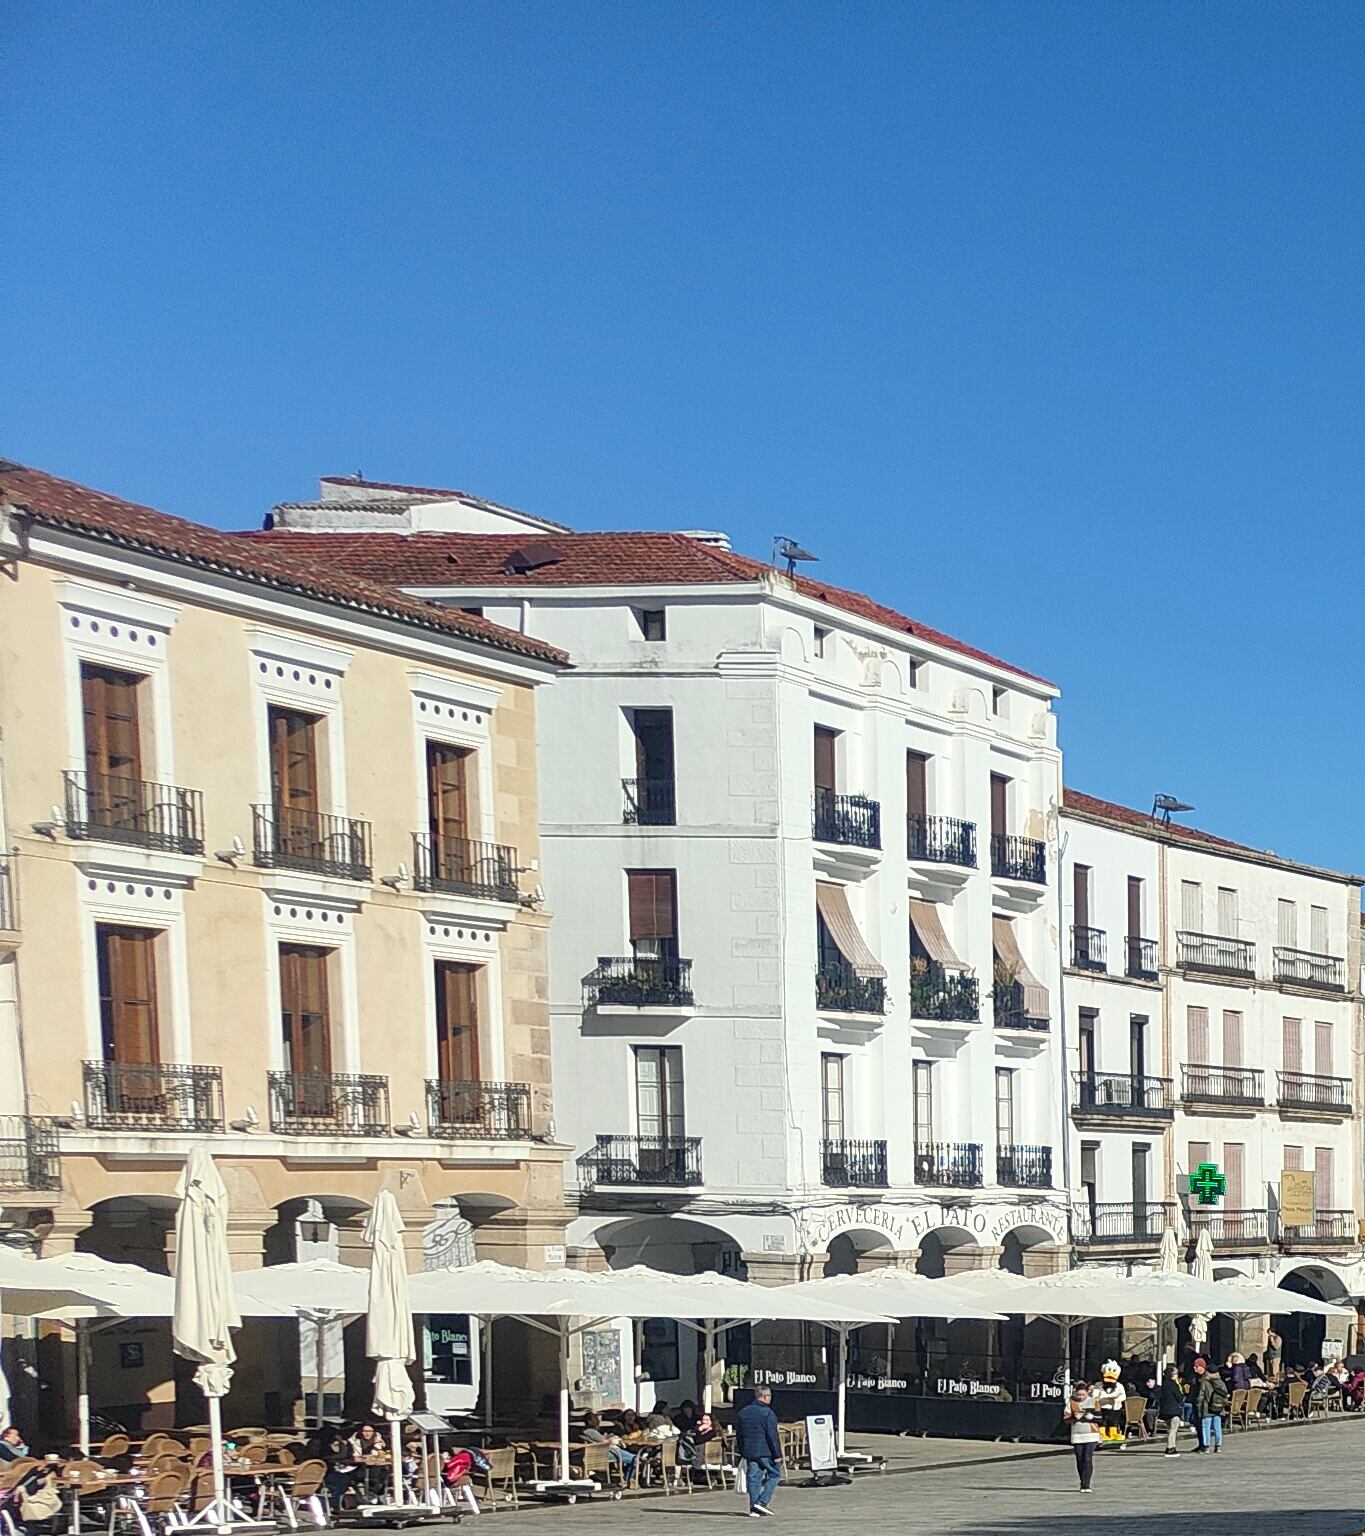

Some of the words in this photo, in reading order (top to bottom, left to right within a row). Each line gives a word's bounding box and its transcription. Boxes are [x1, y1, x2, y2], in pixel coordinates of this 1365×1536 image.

[991, 1207, 1065, 1241] RESTAURANTE
[754, 1370, 763, 1385] El
[765, 1370, 784, 1385] Pato
[786, 1371, 817, 1385] Blanco
[847, 1374, 856, 1388] El
[857, 1375, 876, 1389] Pato
[877, 1376, 907, 1390] Blanco
[937, 1379, 947, 1393] El
[949, 1379, 968, 1394] Pato
[970, 1380, 1000, 1395] Blanco
[1031, 1383, 1040, 1397] El
[1042, 1384, 1062, 1398] Pato
